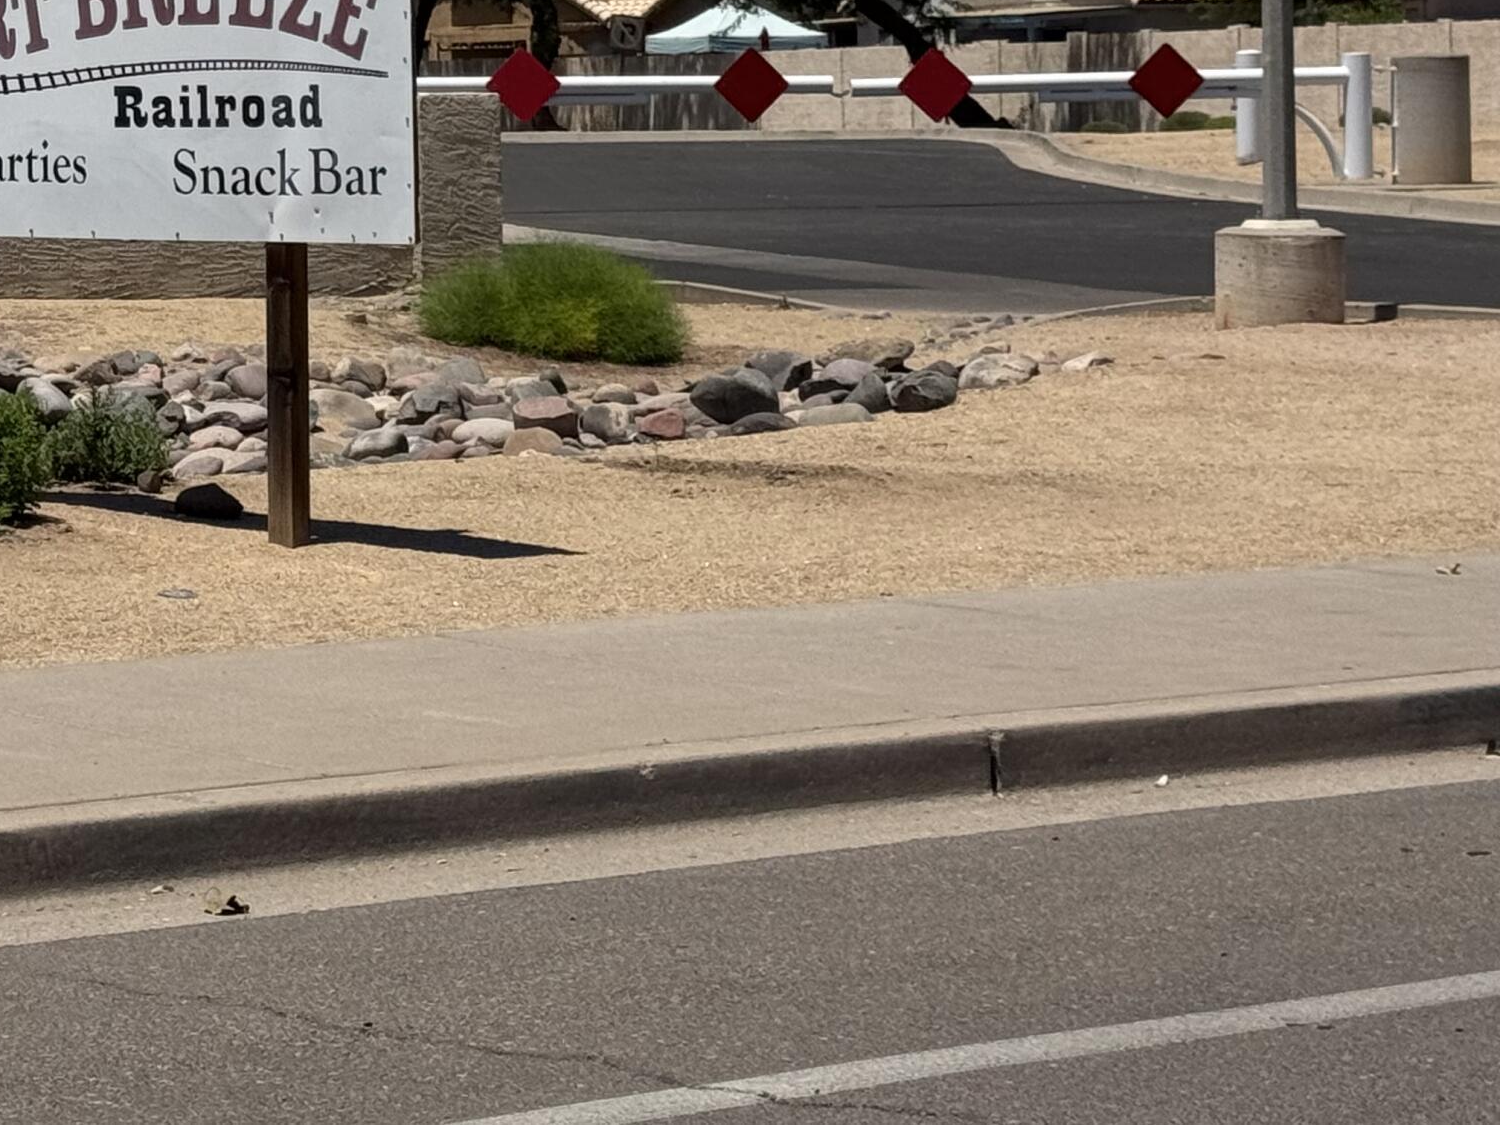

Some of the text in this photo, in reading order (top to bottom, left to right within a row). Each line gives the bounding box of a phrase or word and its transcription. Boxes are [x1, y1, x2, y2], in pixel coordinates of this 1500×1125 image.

[113, 84, 323, 129] Railroad
[172, 147, 388, 197] Snack Bar
